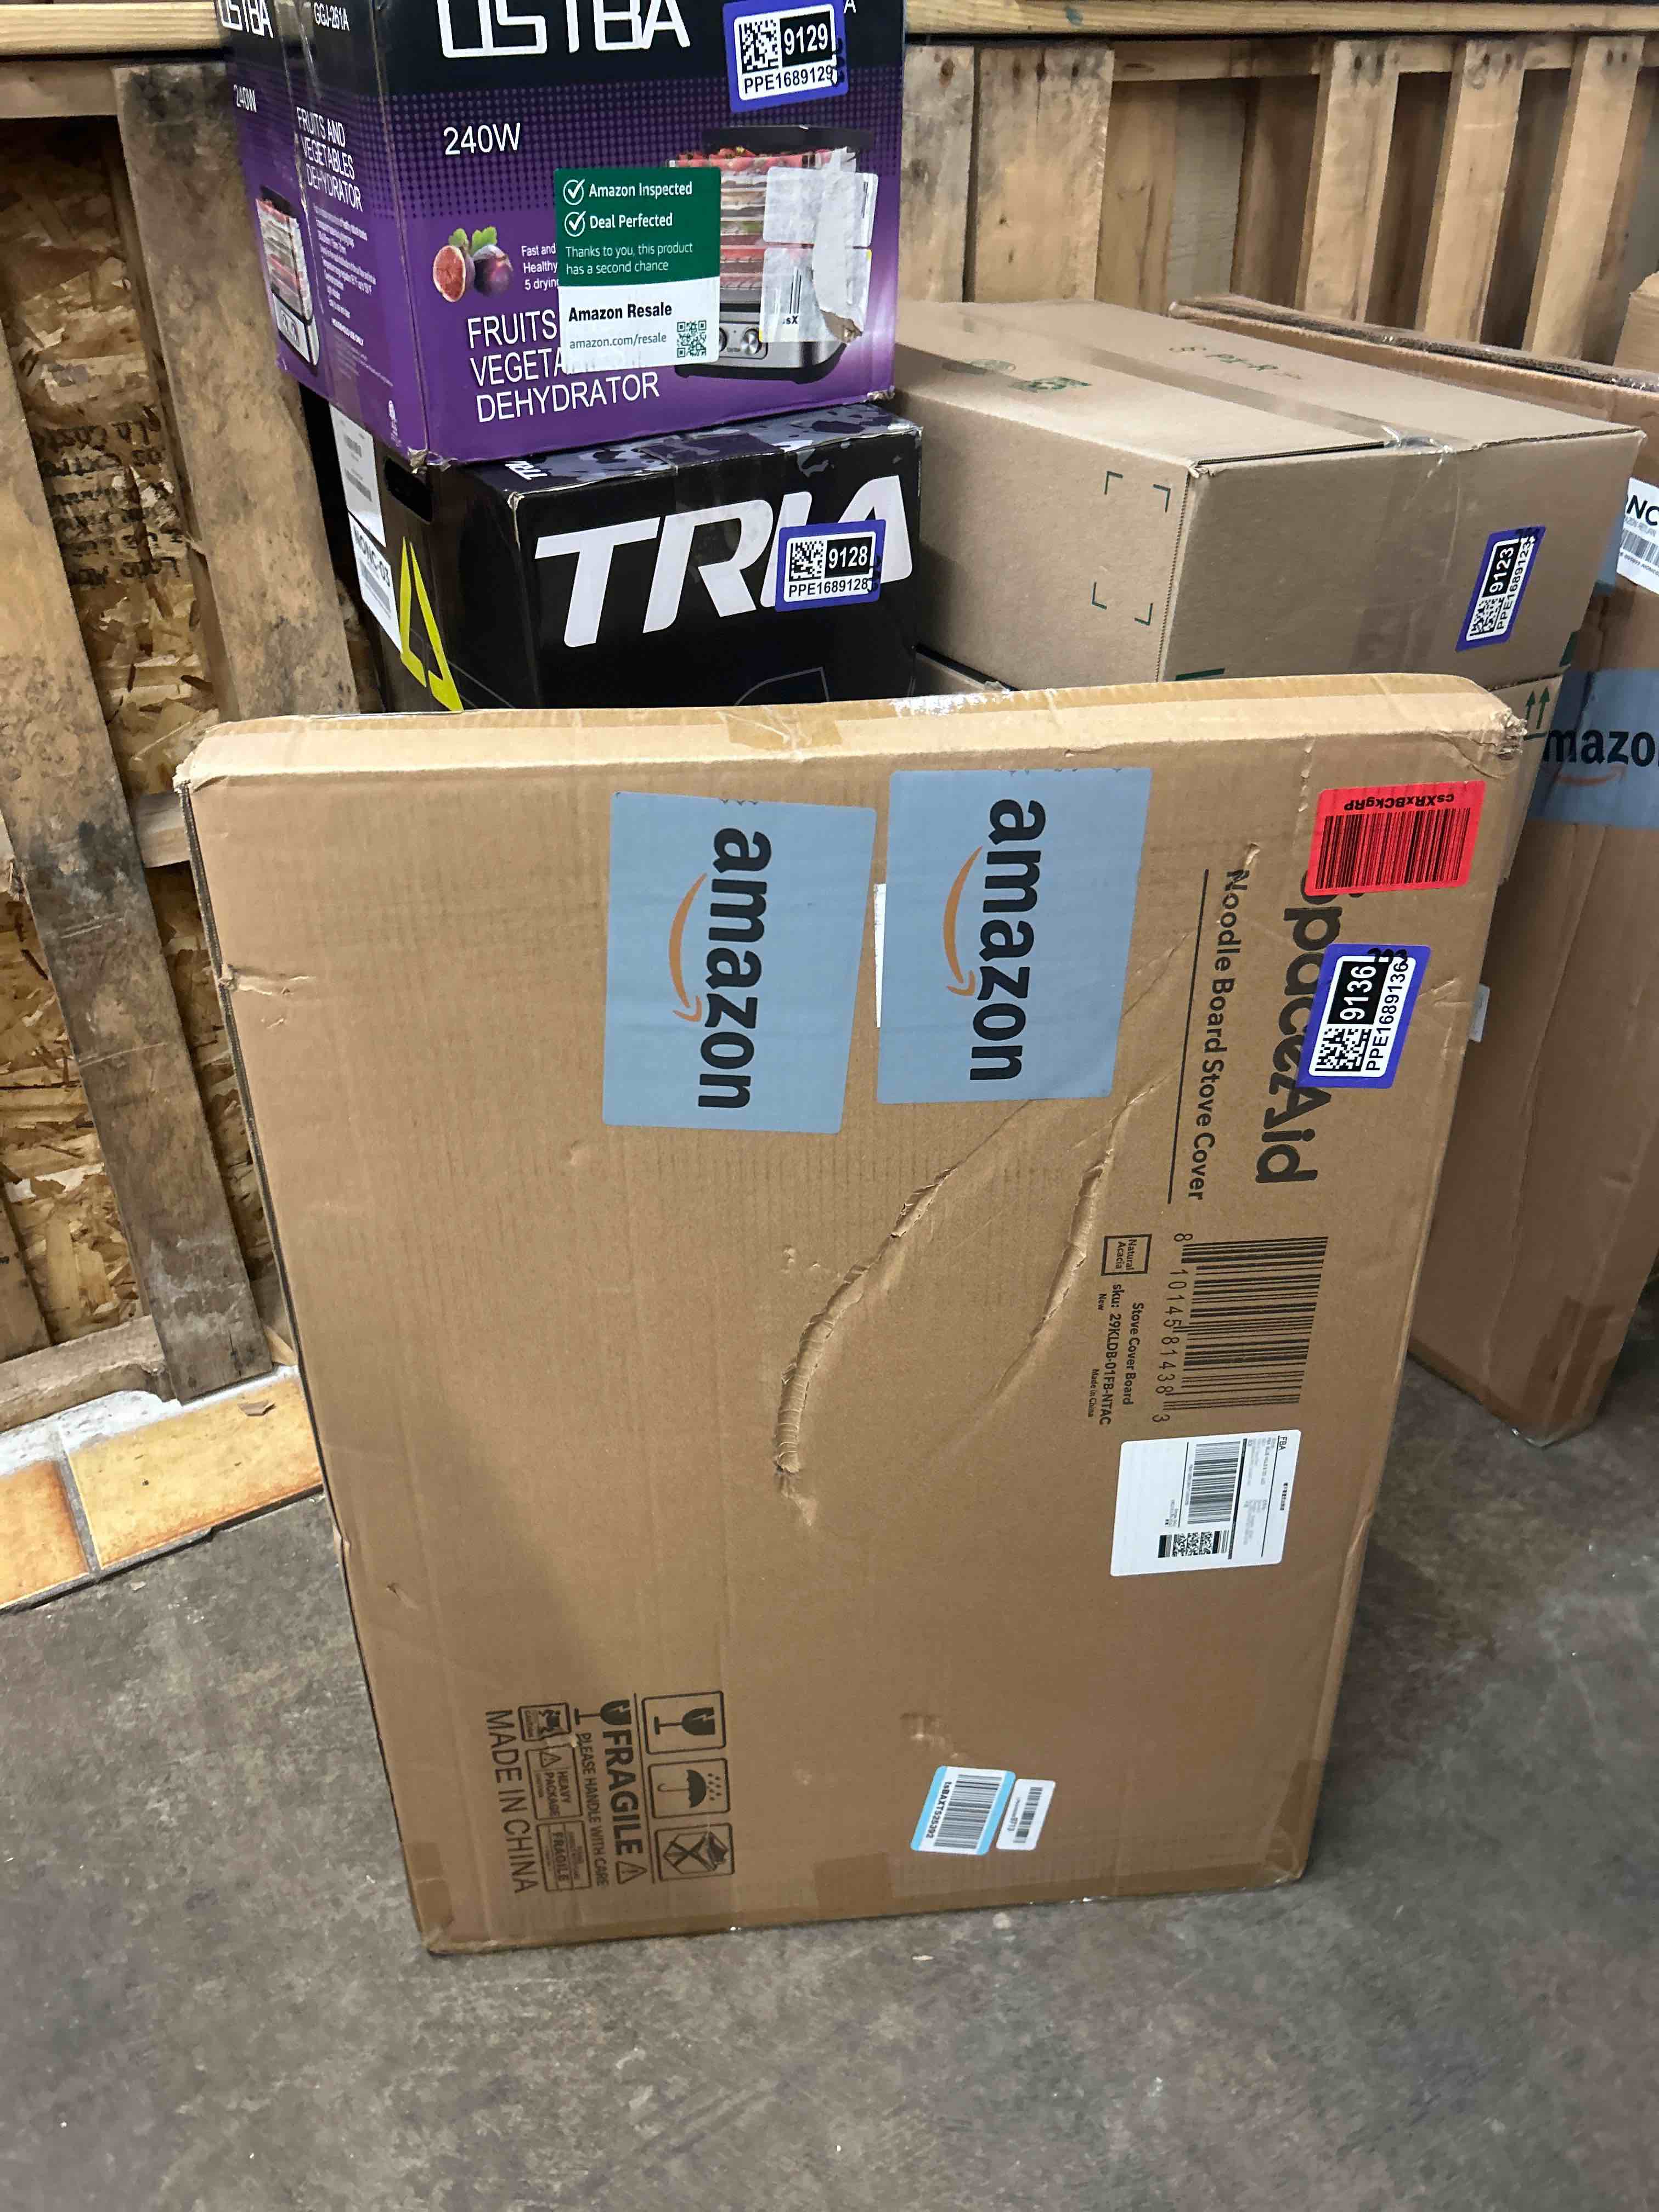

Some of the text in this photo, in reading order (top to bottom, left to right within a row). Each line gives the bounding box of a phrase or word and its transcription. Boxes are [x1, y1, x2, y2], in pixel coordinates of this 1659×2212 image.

[784, 23, 828, 55] 9129
[744, 65, 833, 94] PPE1689129
[296, 106, 346, 148] FRUITS AND
[443, 122, 521, 155] 240W
[301, 135, 356, 180] VEGETABLES
[306, 163, 363, 212] DEHYDRATOR
[589, 181, 692, 199] Amazon Inspected
[590, 212, 673, 229] Deal Perfected
[521, 243, 556, 257] Fast and
[566, 242, 693, 259] Thanks to you, this product
[523, 261, 557, 275] Healthy
[566, 261, 669, 275] has a second chance
[524, 280, 531, 290] 5
[568, 302, 673, 322] Amazon Resale
[467, 309, 557, 348] FRUITS
[569, 332, 667, 349] amazon.com/resale
[476, 371, 659, 423] DEHYDRATOR
[828, 545, 868, 569] 9128
[1489, 547, 1515, 593] 9123
[789, 578, 868, 597] PPE1689128
[1496, 539, 1532, 630] PPE1689123
[1543, 729, 1659, 768] mazo
[1344, 794, 1454, 810] csXRxBCkgRP
[969, 798, 1047, 1082] amazon
[697, 827, 772, 1110] amazon
[1340, 966, 1376, 1020] 9136
[1365, 962, 1409, 1070] PPE1689136
[1188, 869, 1250, 1200] Noodle Board Stove Cover
[1173, 1233, 1193, 1243] 8
[1115, 1242, 1126, 1269] Acacia
[1125, 1239, 1137, 1271] Natural
[1098, 1293, 1107, 1311] New
[1111, 1284, 1125, 1308] sku:
[1122, 1302, 1144, 1406] Stove Cover Board
[1091, 1369, 1100, 1389] Made
[1088, 1397, 1097, 1418] China
[1152, 1414, 1170, 1423] 3
[1278, 1436, 1288, 1451] FBA
[486, 1709, 539, 1894] MADE IN CHINA
[544, 1772, 560, 1818] PACKAGE
[557, 1771, 571, 1803] HEAVY
[602, 1729, 643, 1855] FRAGILE
[575, 1732, 610, 1887] PLEASE HANDLE WITH CARE
[552, 1831, 569, 1882] FRAGILE
